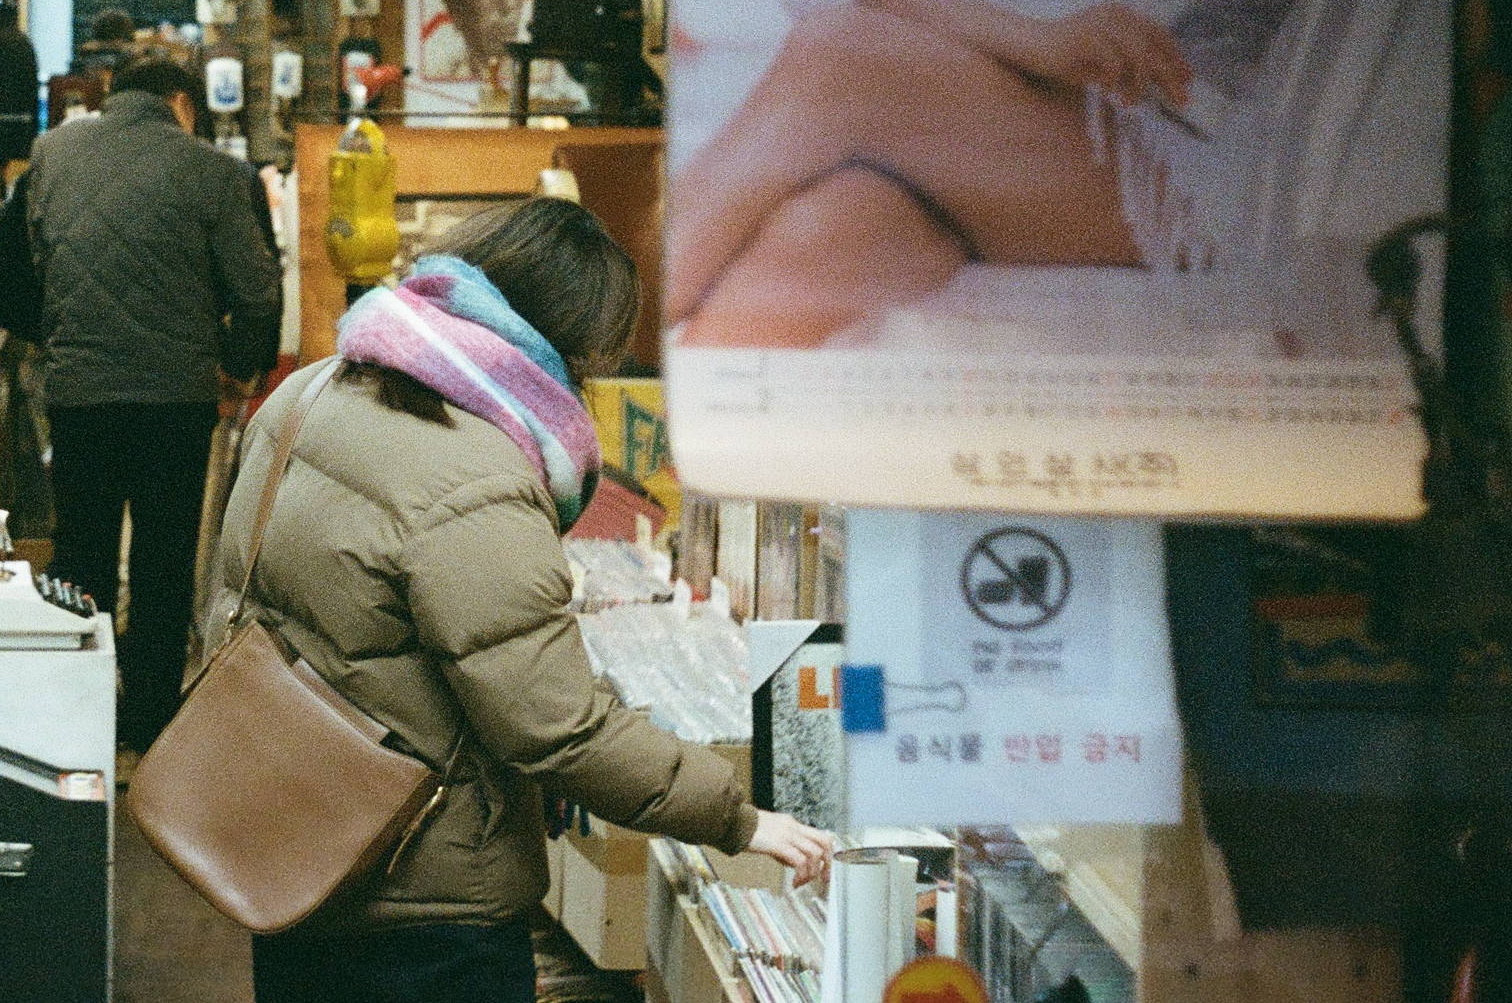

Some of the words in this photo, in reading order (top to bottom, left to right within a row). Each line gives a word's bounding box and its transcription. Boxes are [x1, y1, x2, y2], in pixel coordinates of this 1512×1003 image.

[897, 733, 983, 763] 음식물
[1003, 733, 1063, 763] 반입
[1084, 733, 1142, 763] 금지
